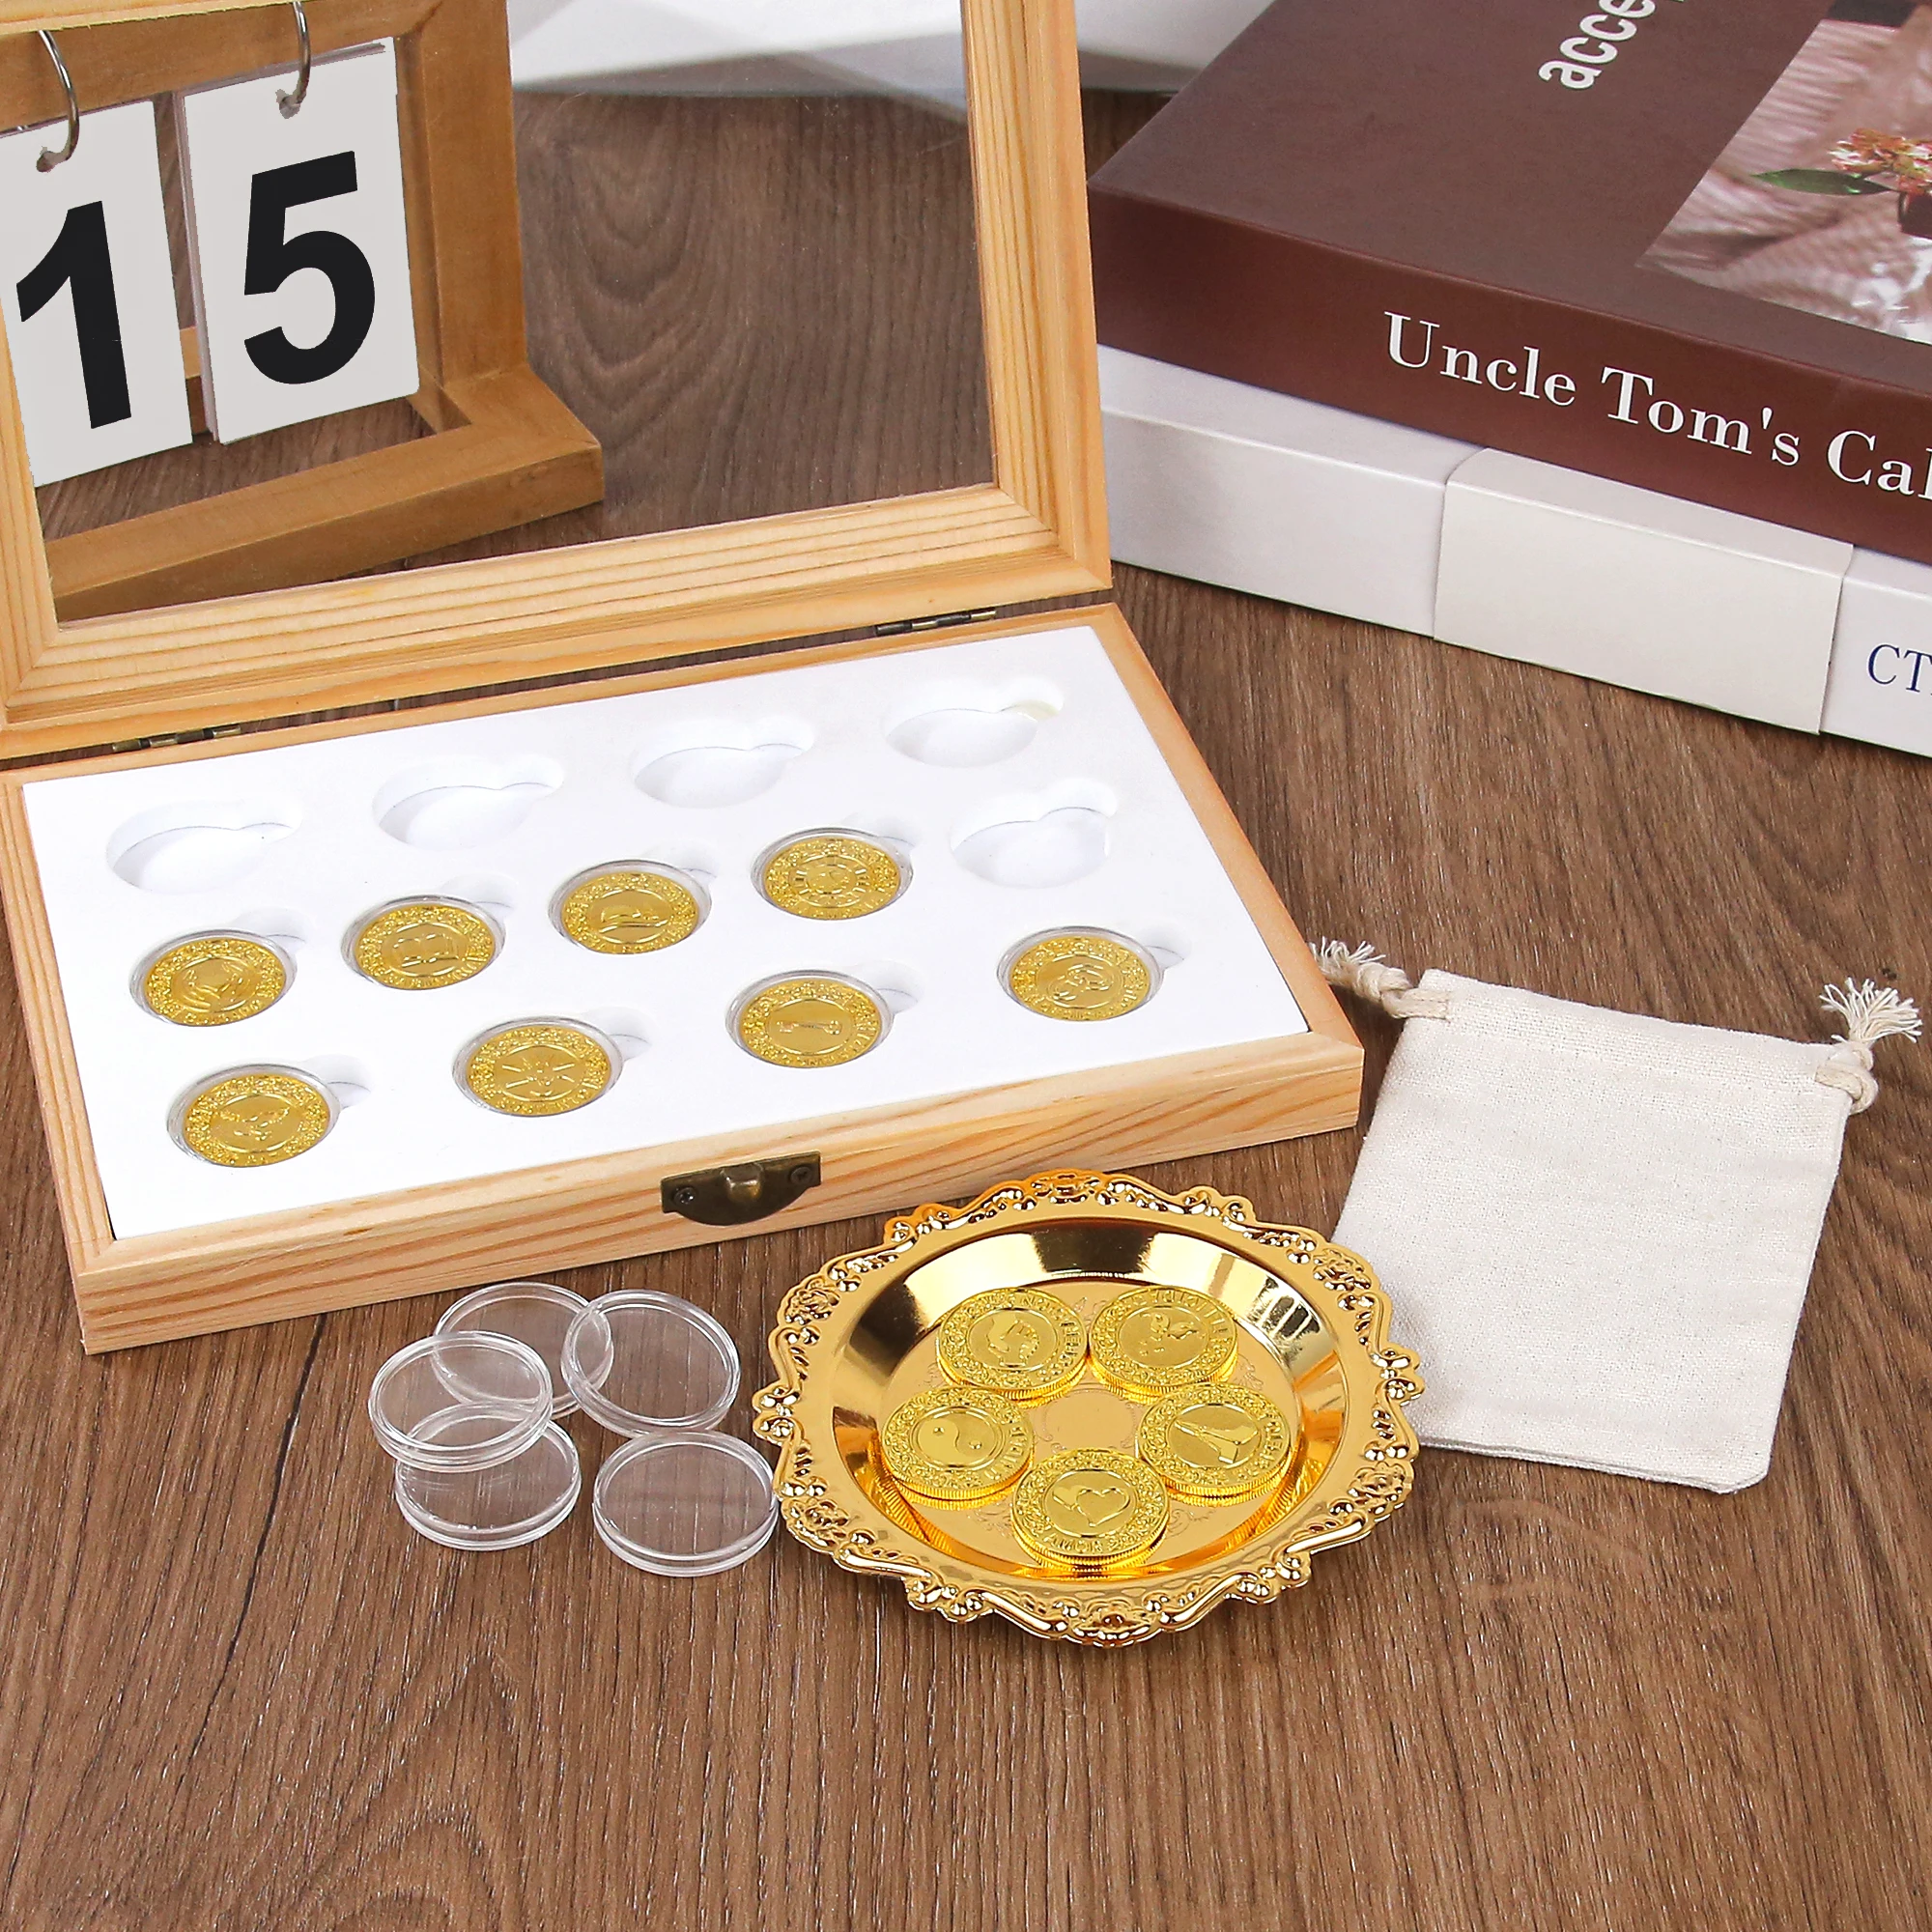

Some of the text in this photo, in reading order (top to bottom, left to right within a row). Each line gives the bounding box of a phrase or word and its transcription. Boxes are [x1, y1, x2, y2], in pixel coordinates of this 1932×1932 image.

[1538, 0, 1684, 89] acce
[1383, 311, 1576, 406] Uncle
[1601, 366, 1800, 466] Tom's
[1867, 643, 1932, 696] CT
